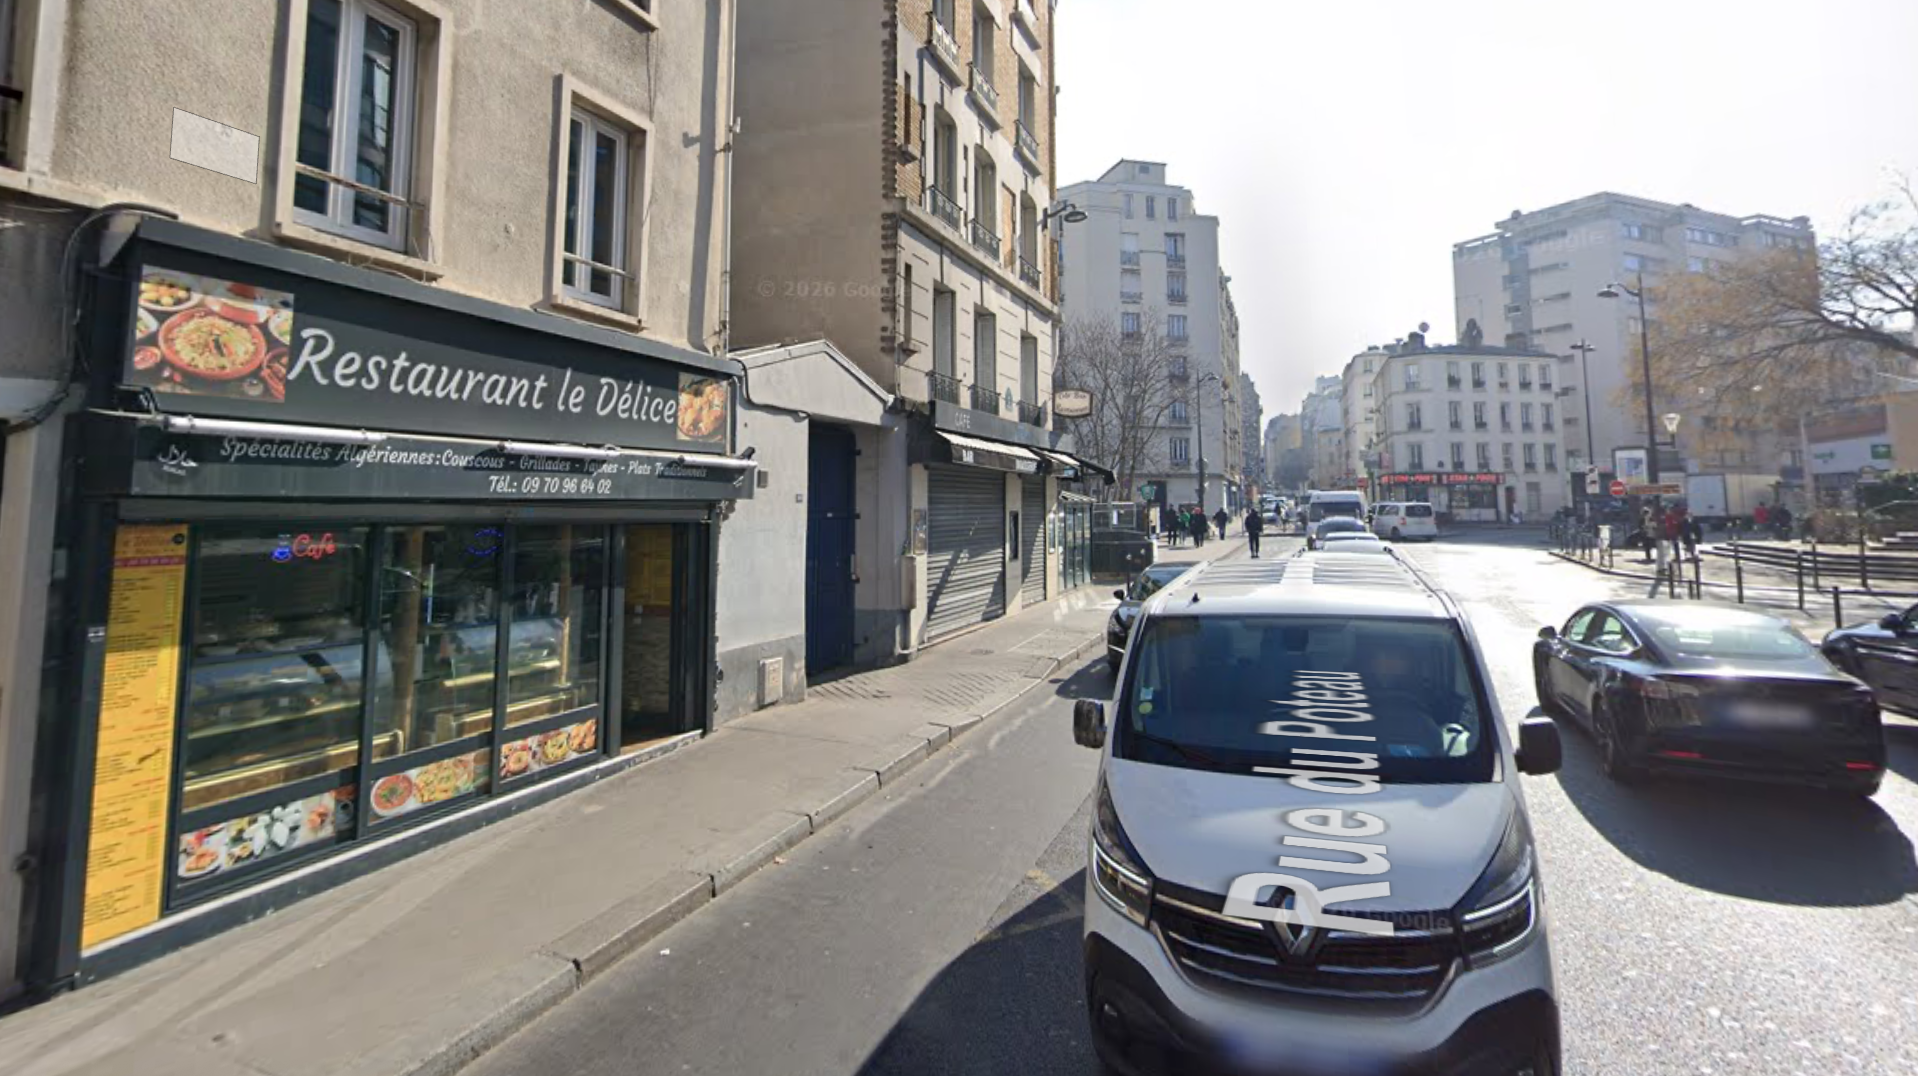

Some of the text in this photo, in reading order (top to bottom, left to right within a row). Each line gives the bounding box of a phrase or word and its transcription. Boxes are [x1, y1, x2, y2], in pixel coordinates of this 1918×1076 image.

[287, 327, 677, 424] Restaurant le Délice
[220, 434, 333, 462] Spécialités
[520, 454, 571, 471] Grillades
[627, 460, 652, 474] Plats
[521, 476, 541, 493] 09
[543, 477, 560, 493] 70
[562, 478, 578, 494] 96
[581, 478, 595, 494] 64
[597, 479, 612, 494] 02
